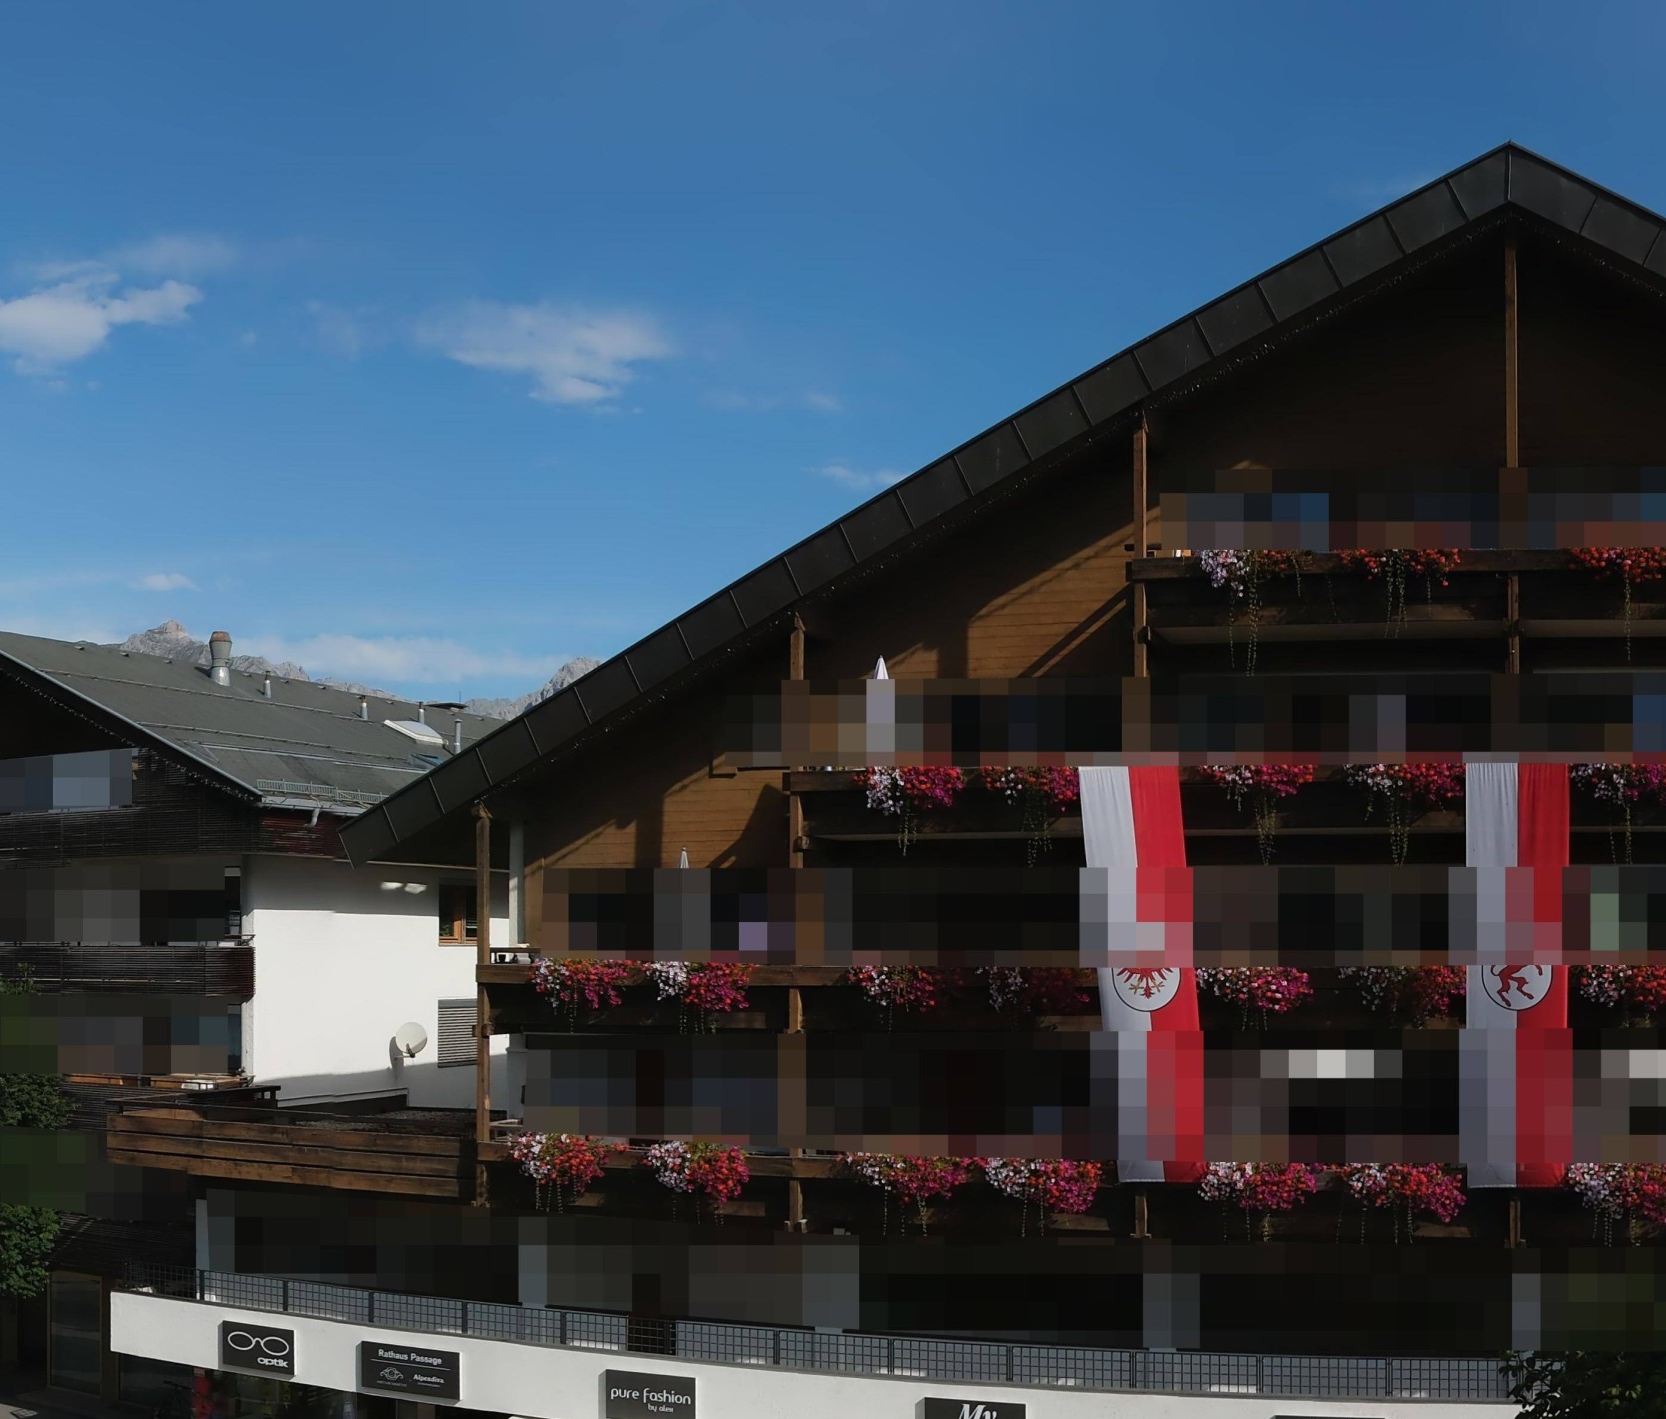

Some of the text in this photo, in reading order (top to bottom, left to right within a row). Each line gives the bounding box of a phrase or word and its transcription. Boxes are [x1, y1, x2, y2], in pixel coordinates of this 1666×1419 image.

[257, 1357, 289, 1368] optik
[378, 1349, 442, 1366] Rathaus Passage
[611, 1387, 691, 1405] pure fashion
[647, 1403, 657, 1412] by
